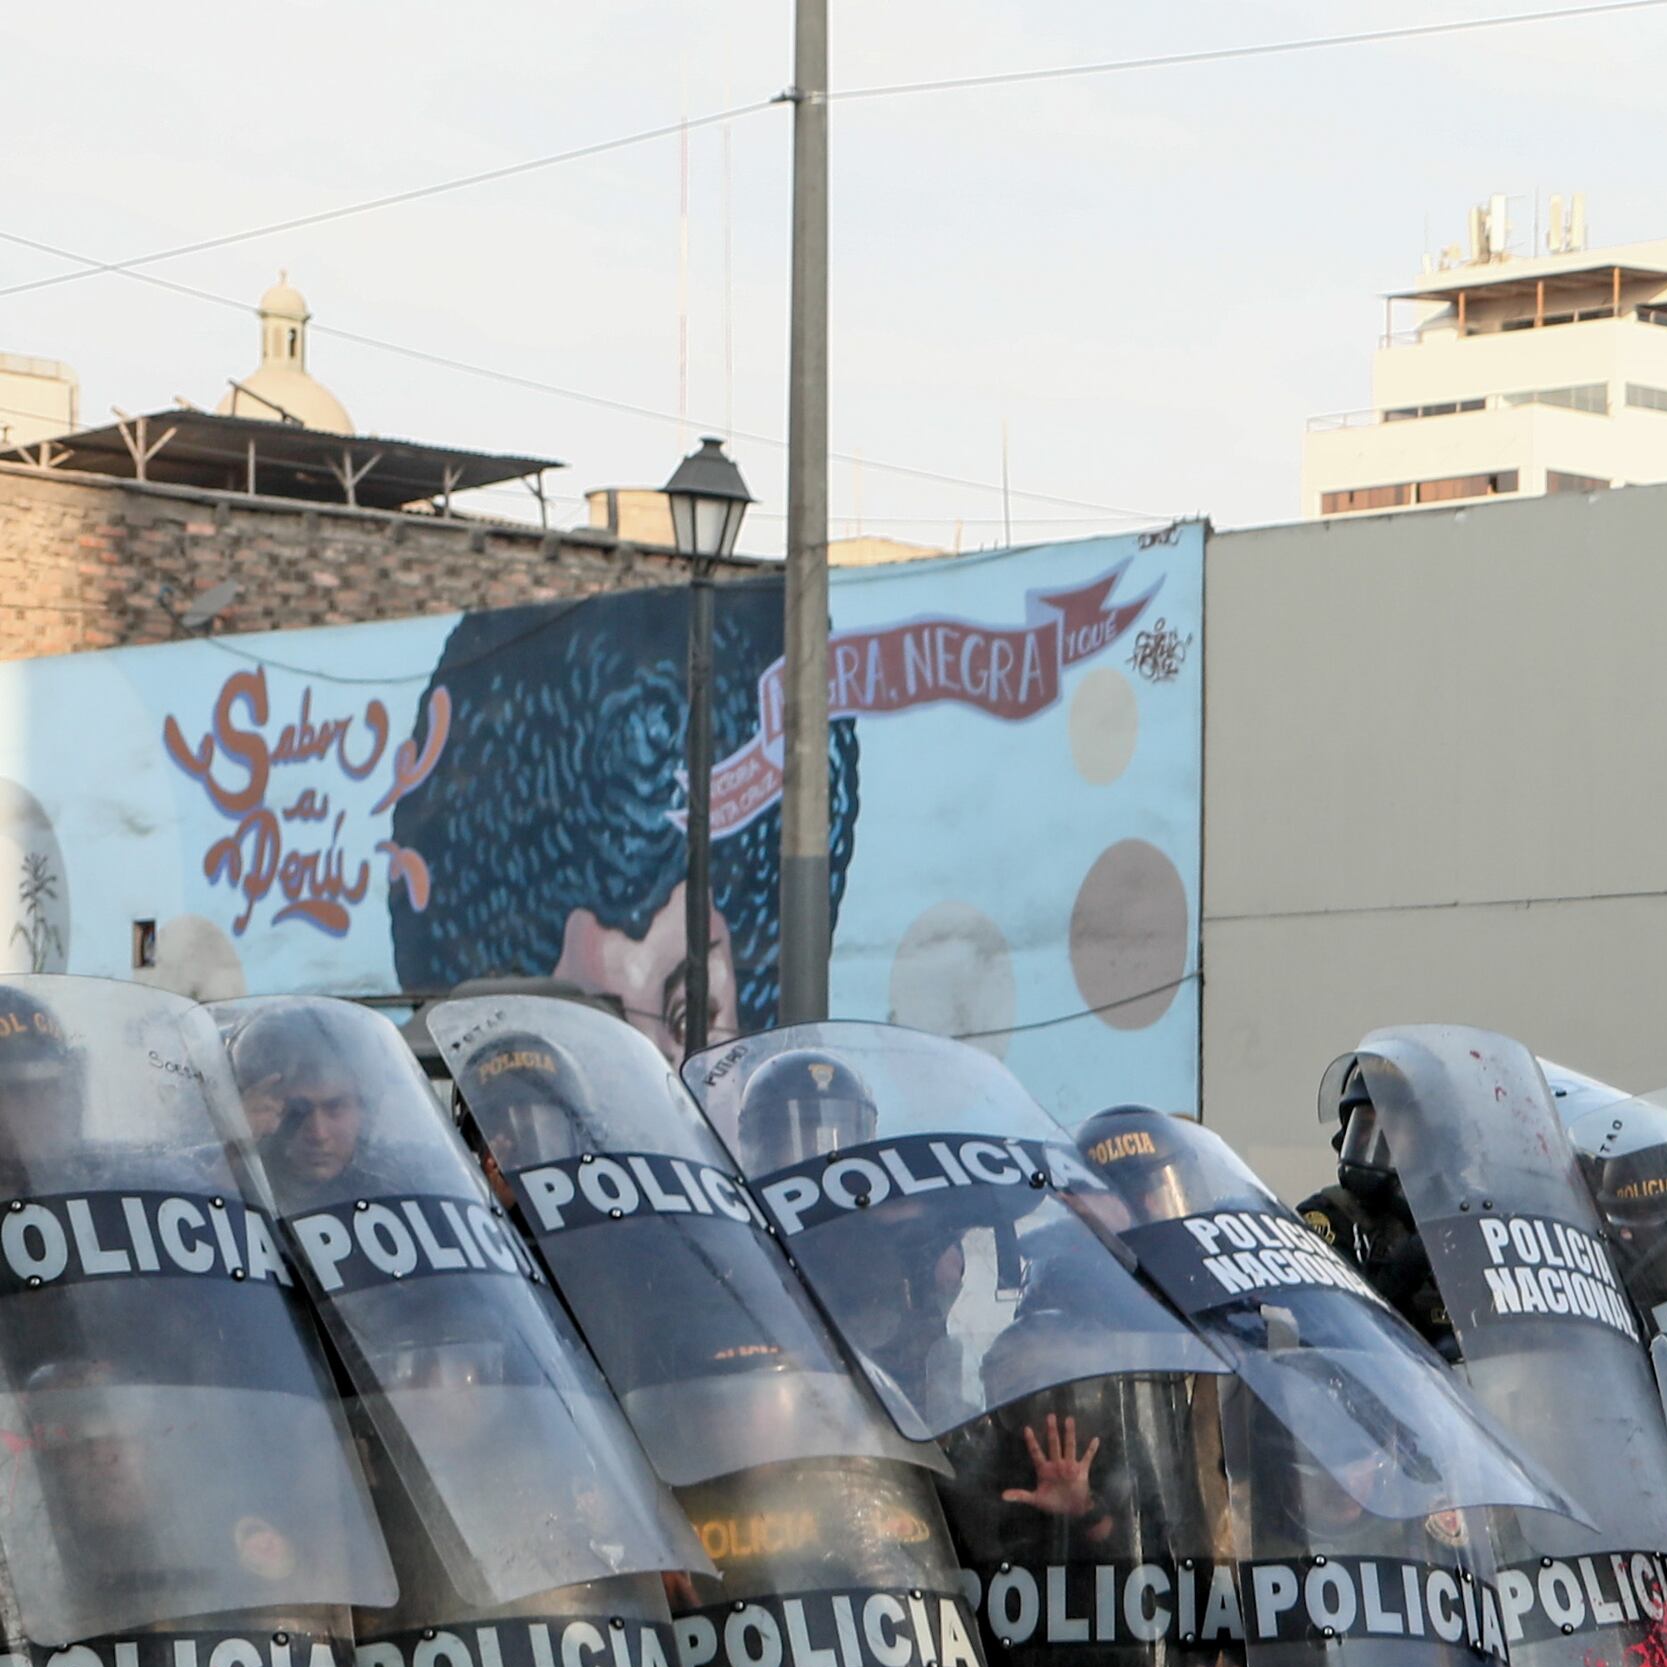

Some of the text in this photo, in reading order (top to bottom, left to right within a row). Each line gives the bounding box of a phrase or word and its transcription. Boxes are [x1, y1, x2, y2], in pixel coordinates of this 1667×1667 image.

[904, 632, 1044, 701] NEGRA
[164, 664, 389, 821] Sabor
[281, 789, 329, 821] a
[204, 808, 370, 937] Perú
[761, 1139, 1107, 1237] POLICIA
[0, 1197, 293, 1286] OLICIA
[1480, 1218, 1617, 1288] POLICIA
[1483, 1267, 1640, 1344] NACIONAL
[958, 1563, 1245, 1645] POLICIA
[1252, 1560, 1508, 1664] POLICIA
